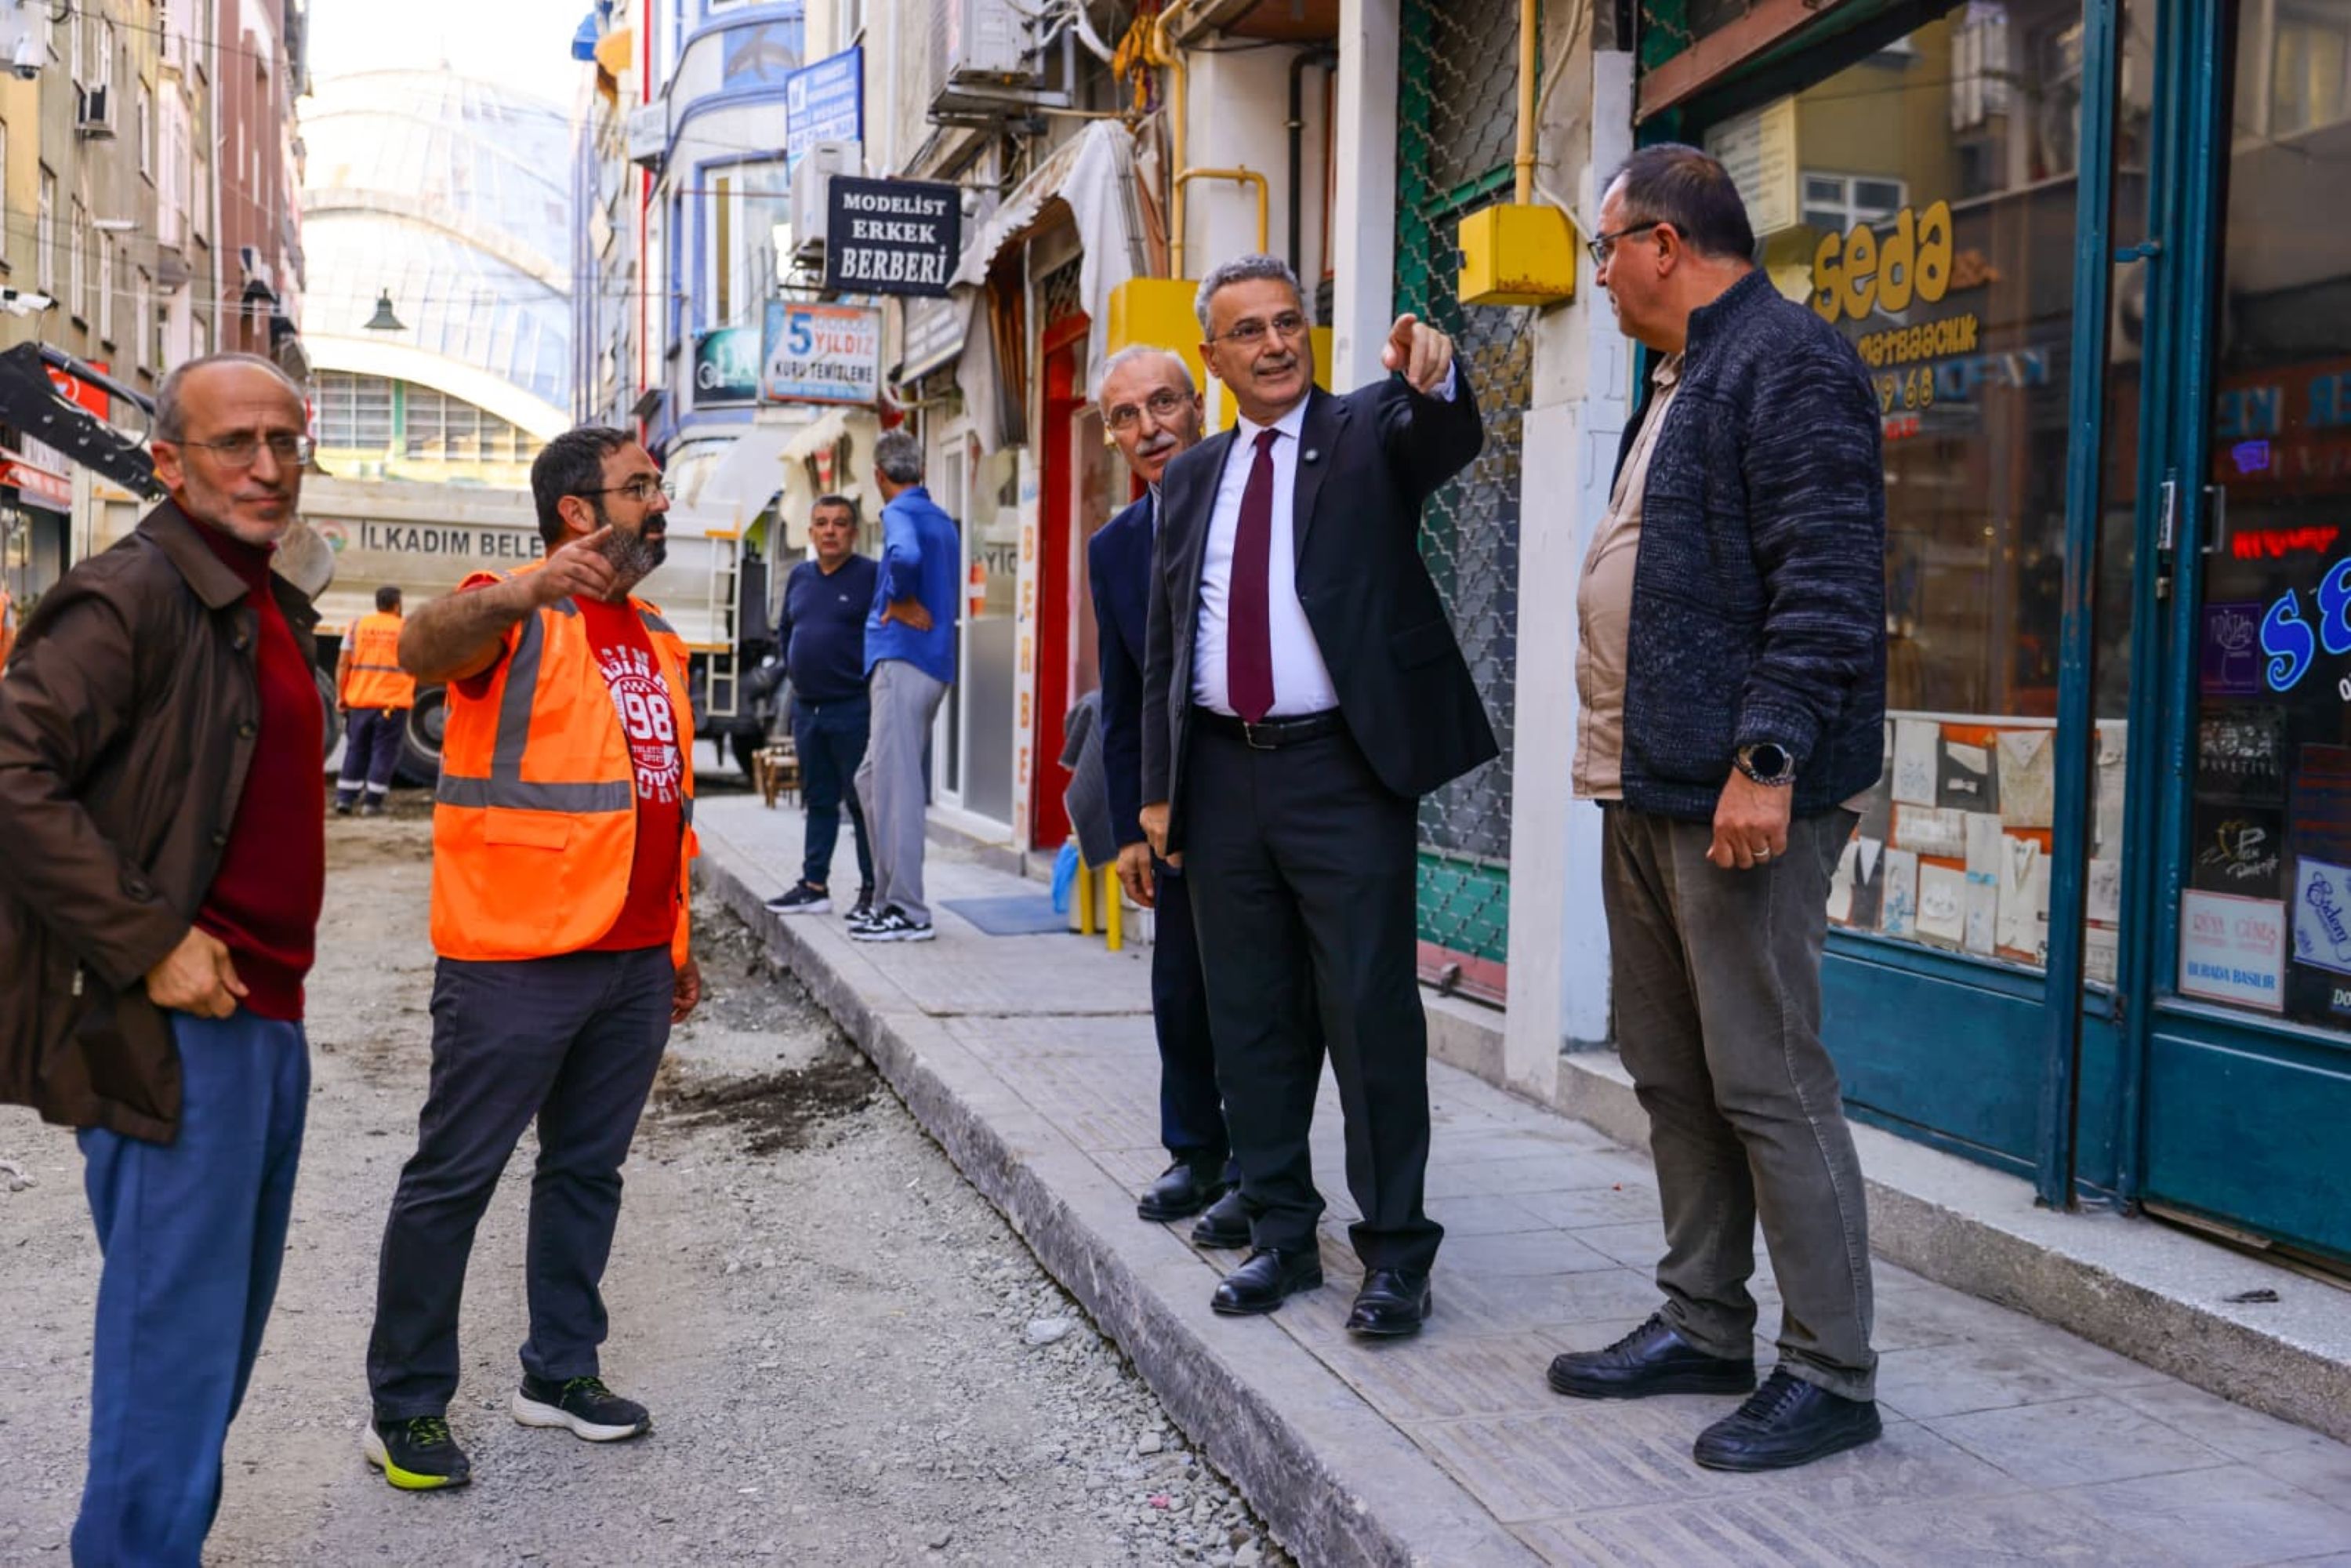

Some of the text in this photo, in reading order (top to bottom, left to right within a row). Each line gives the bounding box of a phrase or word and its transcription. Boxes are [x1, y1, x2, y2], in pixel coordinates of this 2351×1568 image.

[844, 193, 946, 216] MODELİST
[852, 219, 936, 244] ERKEK
[840, 245, 947, 285] BERBERİ
[1813, 199, 1952, 324] seda
[788, 312, 812, 355] 5
[361, 517, 544, 559] İLKADIM BELE
[624, 692, 674, 742] 98
